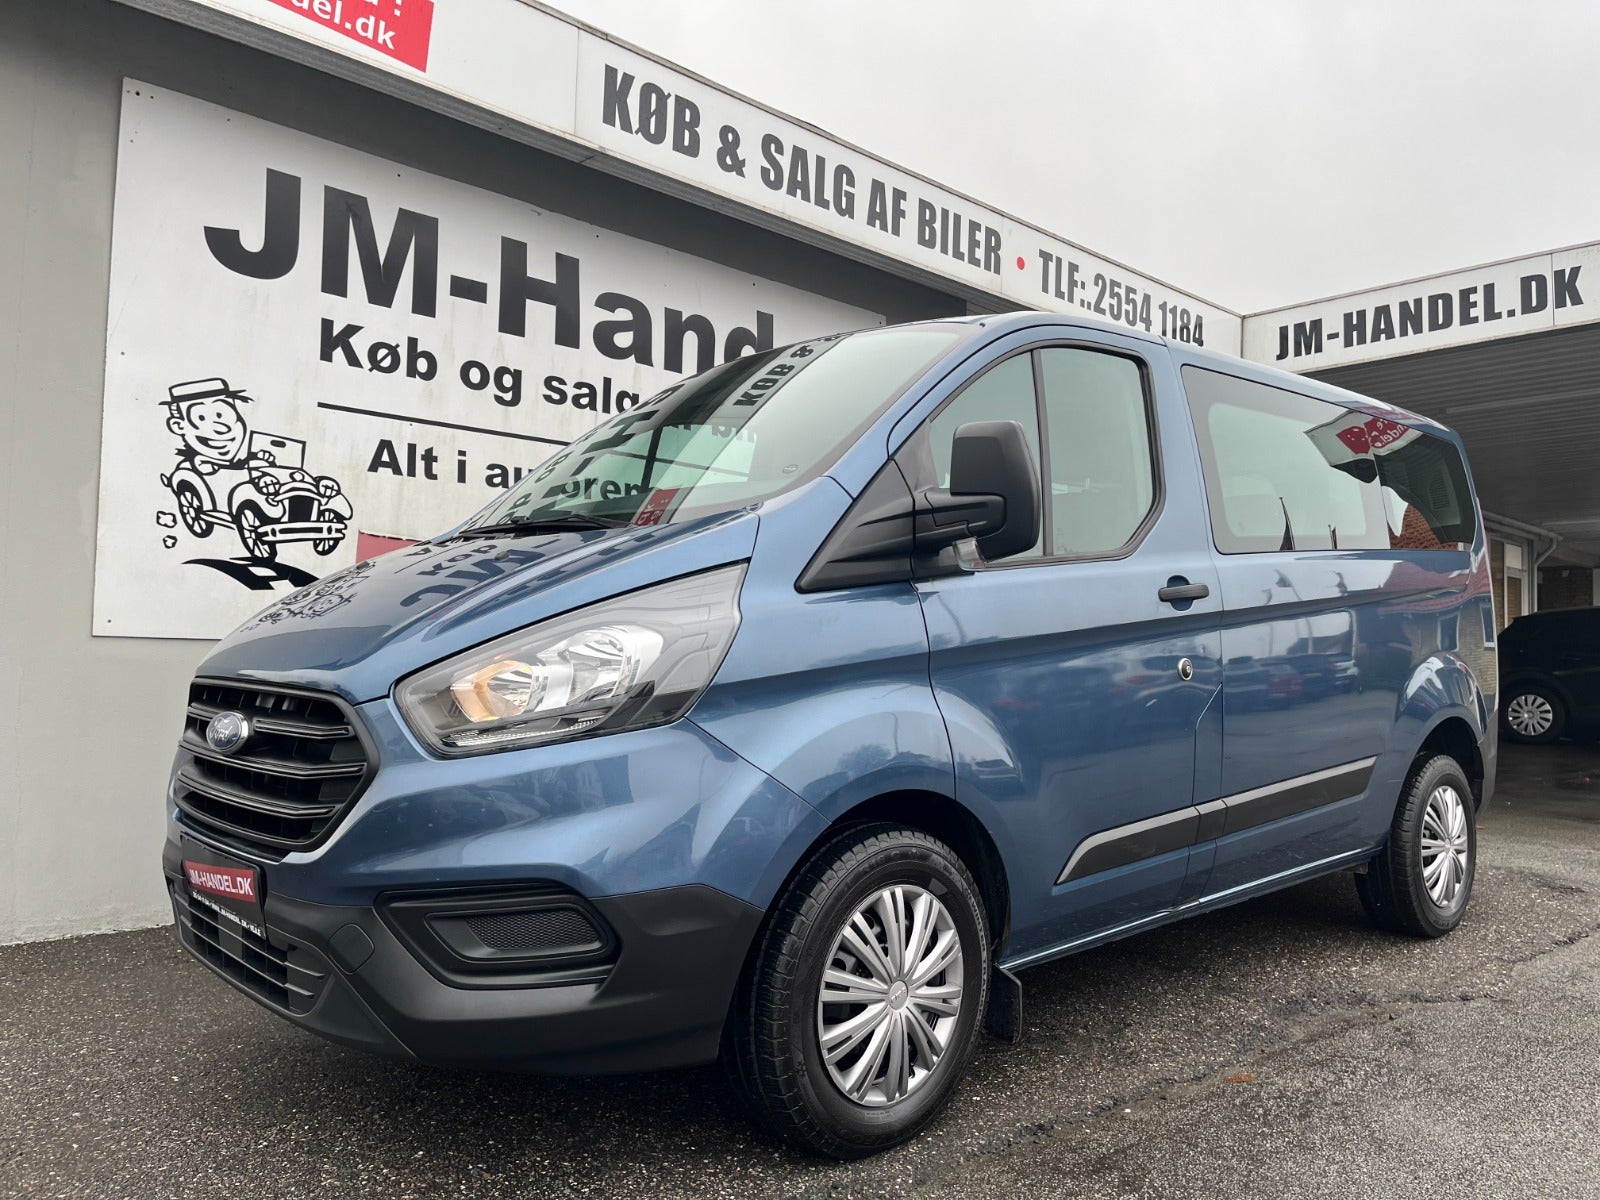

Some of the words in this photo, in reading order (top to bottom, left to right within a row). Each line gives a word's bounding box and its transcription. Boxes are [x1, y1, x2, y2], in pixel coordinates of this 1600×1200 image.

[602, 64, 701, 158] KØB
[716, 124, 747, 178] &
[760, 133, 857, 218] SALG
[866, 180, 908, 237] AF
[917, 197, 1002, 275] BILER
[1158, 301, 1204, 347] 1184
[1276, 265, 1584, 361] JM-HANDEL.DK
[320, 317, 438, 381] Køb
[459, 360, 522, 407] og
[367, 438, 438, 480] Alt
[457, 450, 467, 484] i
